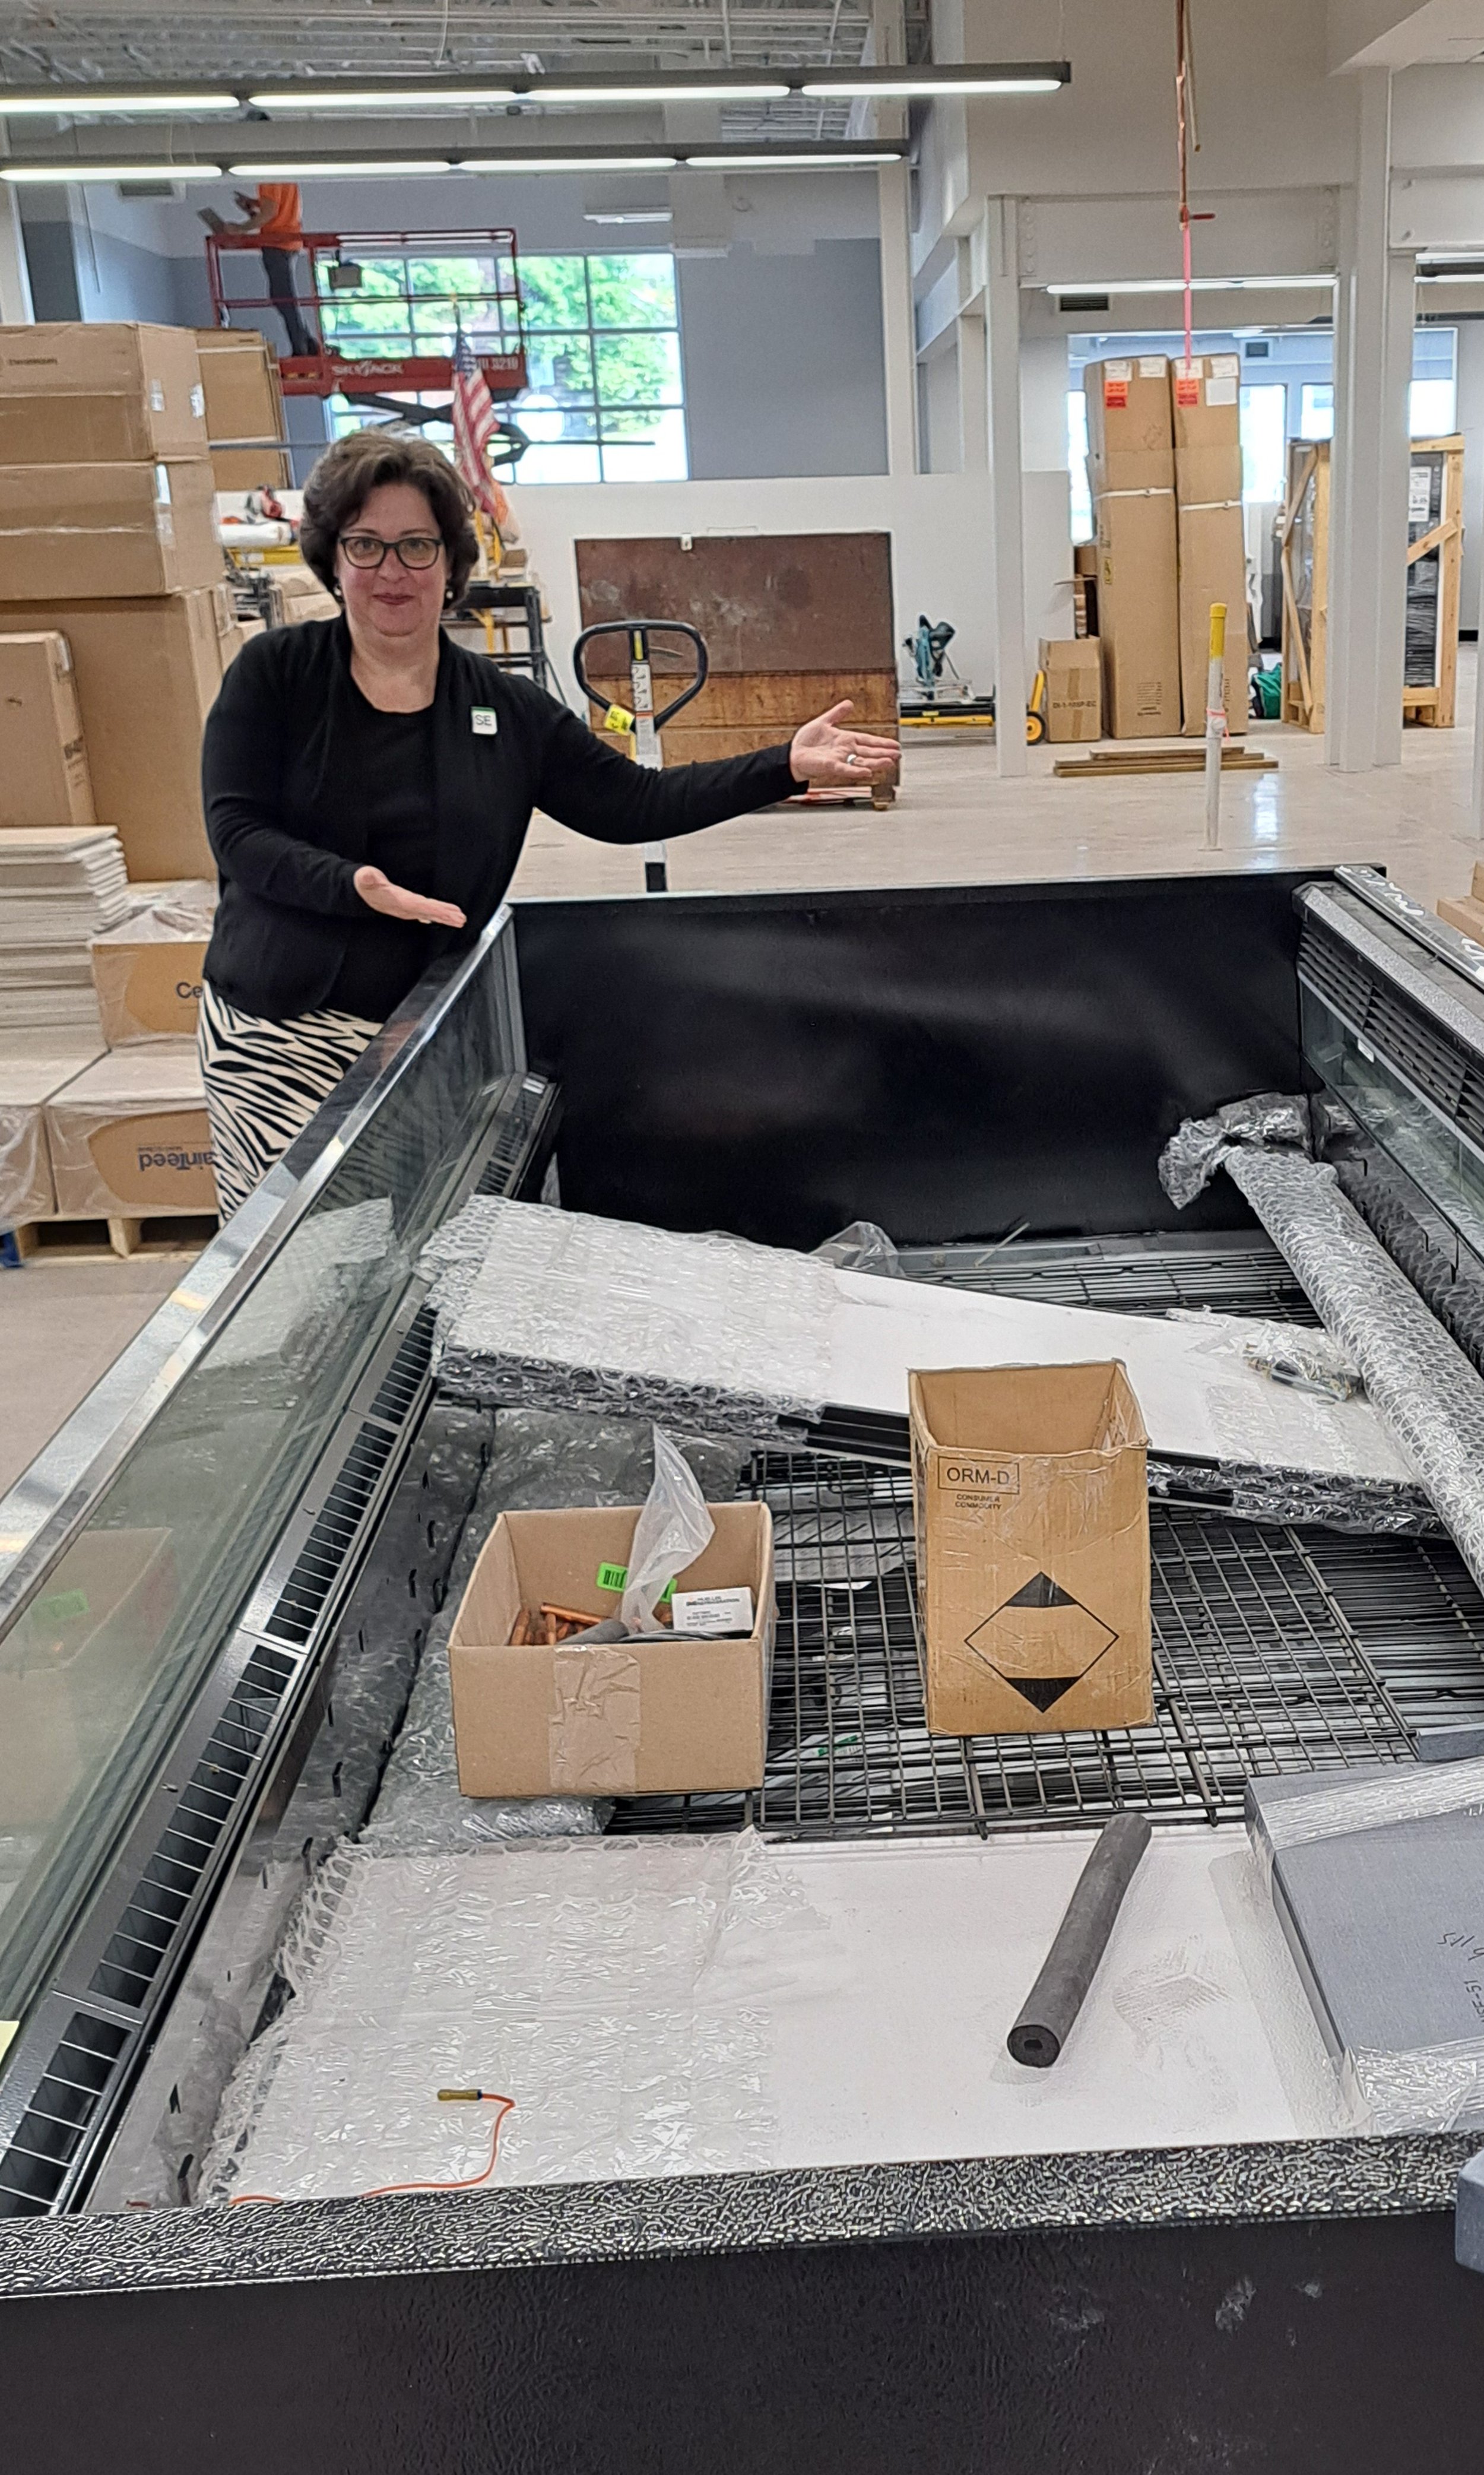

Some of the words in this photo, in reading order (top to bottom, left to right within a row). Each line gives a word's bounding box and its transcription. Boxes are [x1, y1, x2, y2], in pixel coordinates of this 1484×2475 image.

[475, 714, 492, 725] SE
[947, 1467, 1010, 1484] ORM-D
[956, 1494, 1000, 1503] CONSUMER
[955, 1501, 1002, 1510] COMMODITY
